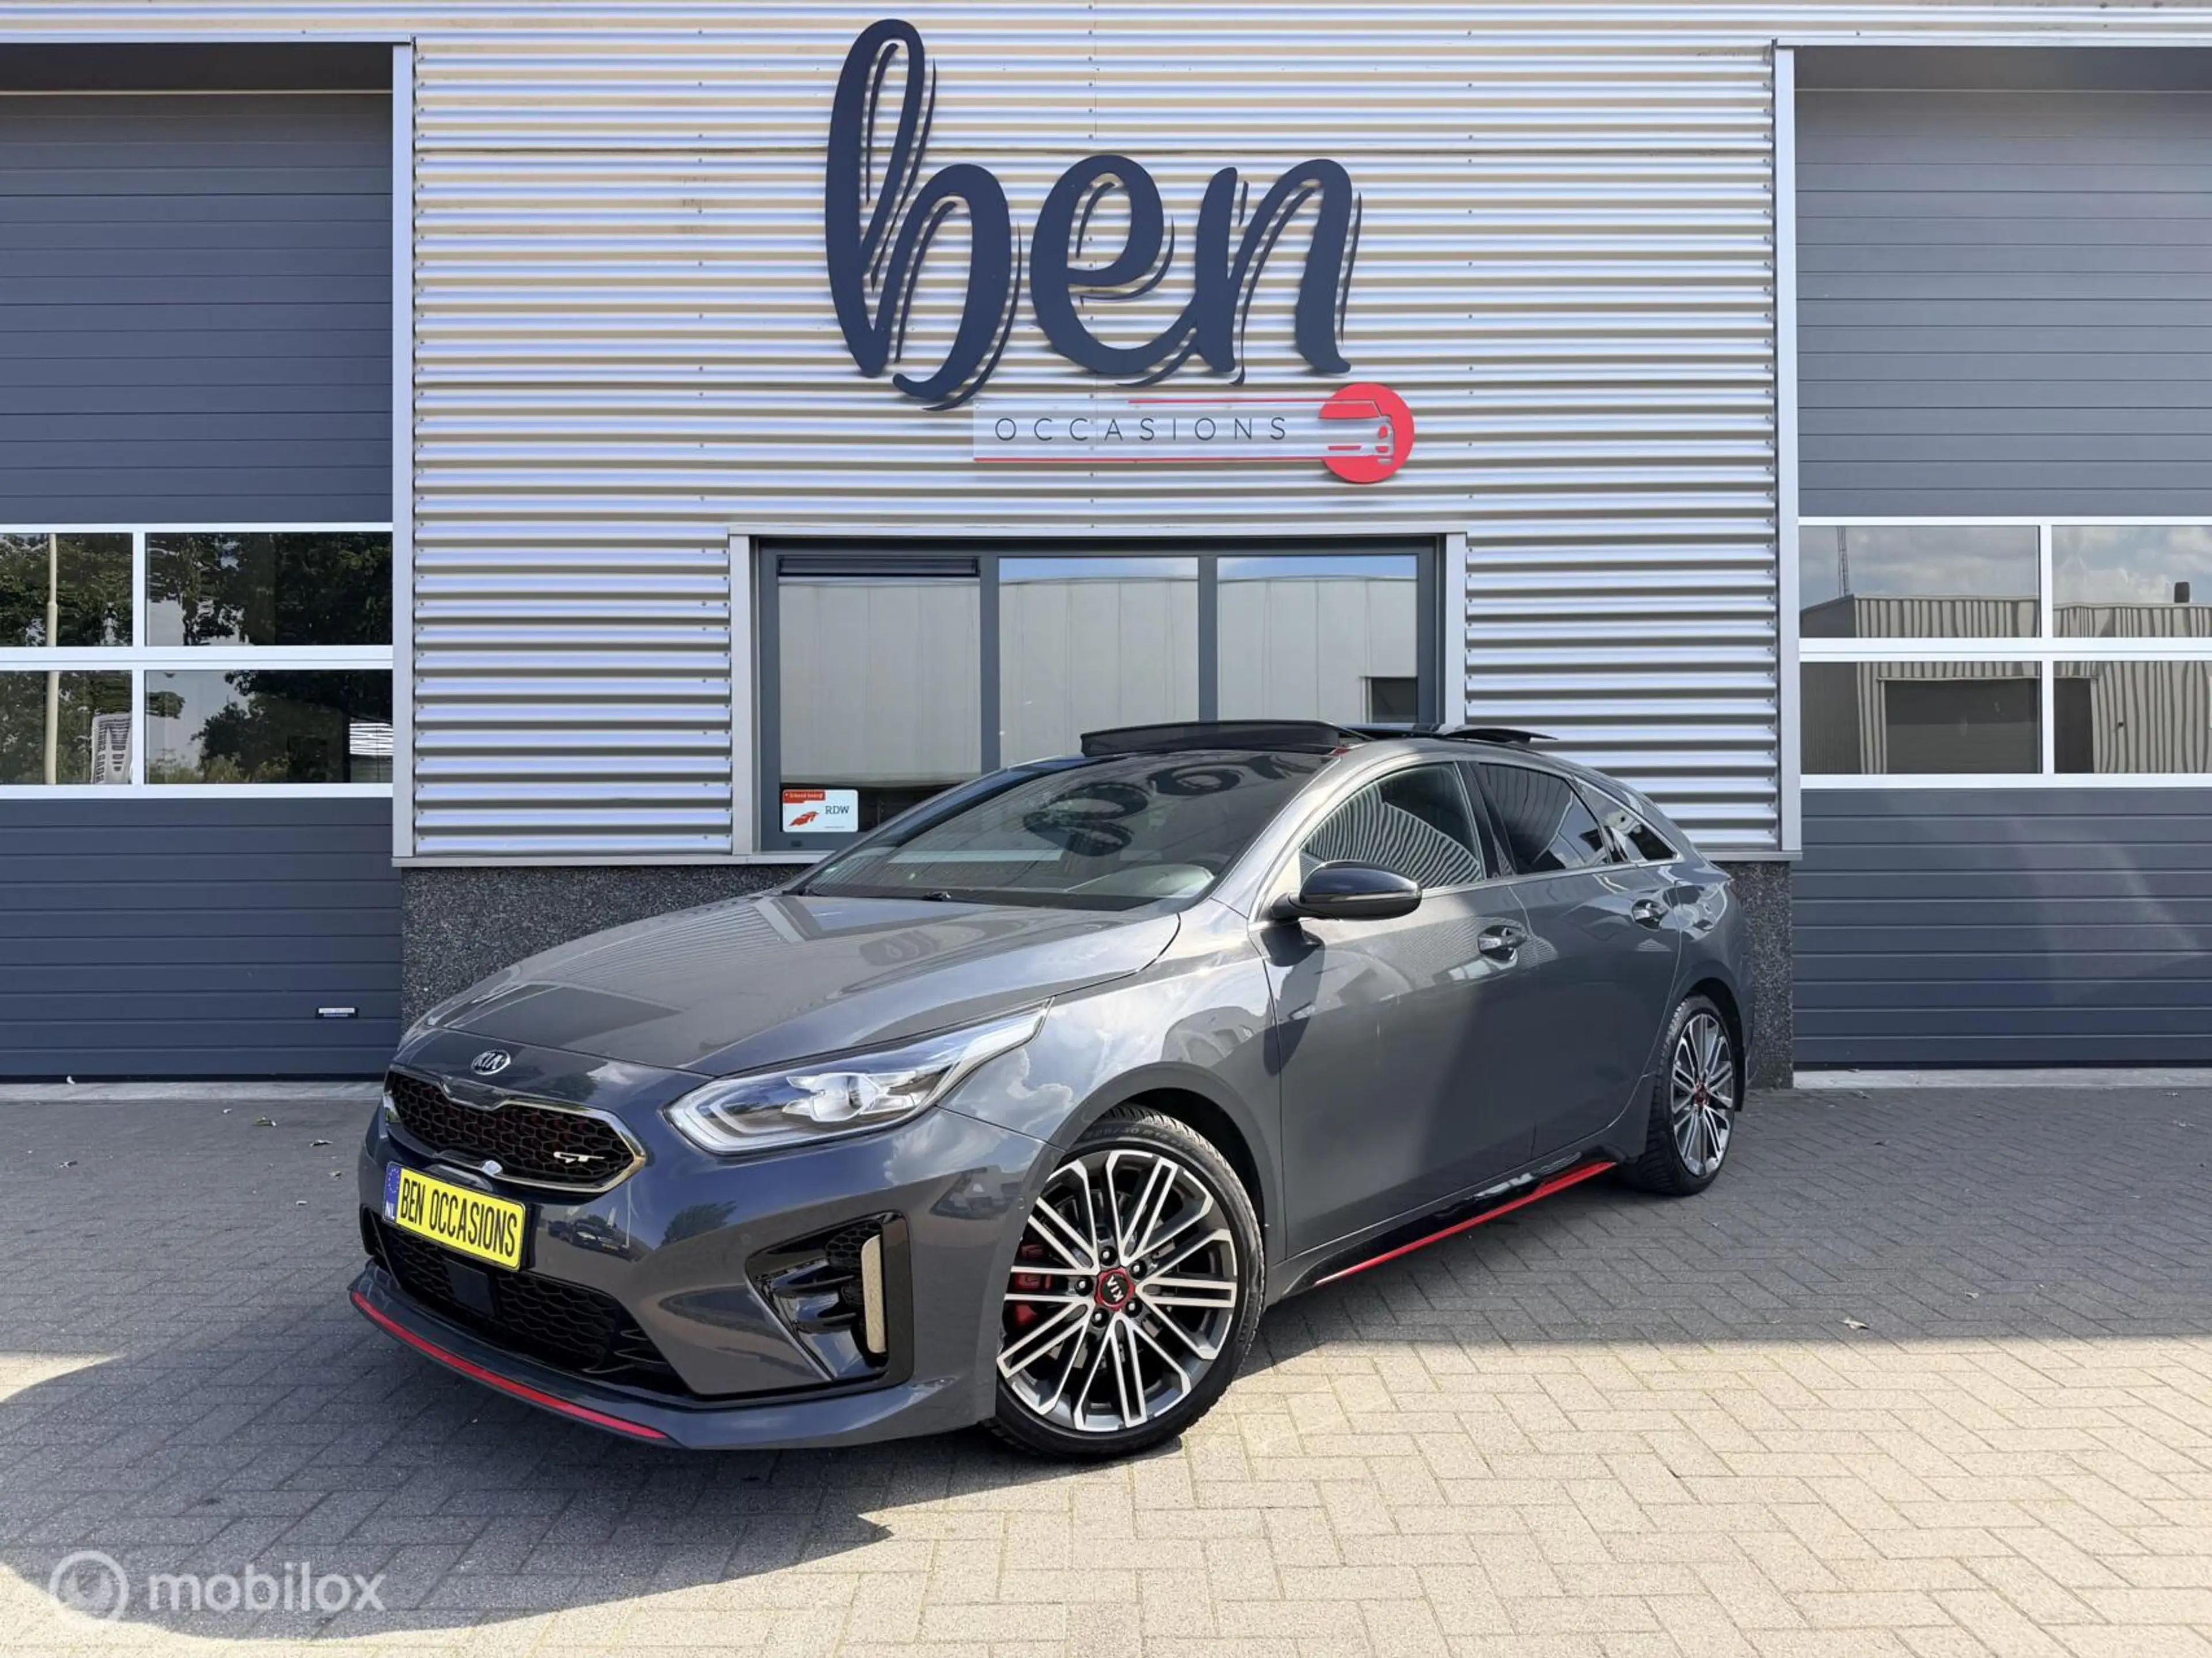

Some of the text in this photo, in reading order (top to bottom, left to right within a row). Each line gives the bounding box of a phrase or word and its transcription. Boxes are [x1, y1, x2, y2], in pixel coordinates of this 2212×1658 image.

[825, 18, 1362, 411] ben
[994, 416, 1288, 443] OCCASIONS
[825, 805, 850, 814] RDW
[554, 1151, 605, 1163] GT
[385, 1201, 395, 1220] NL
[400, 1178, 517, 1257] BEN OCCASIONS
[1107, 1275, 1124, 1302] KIA
